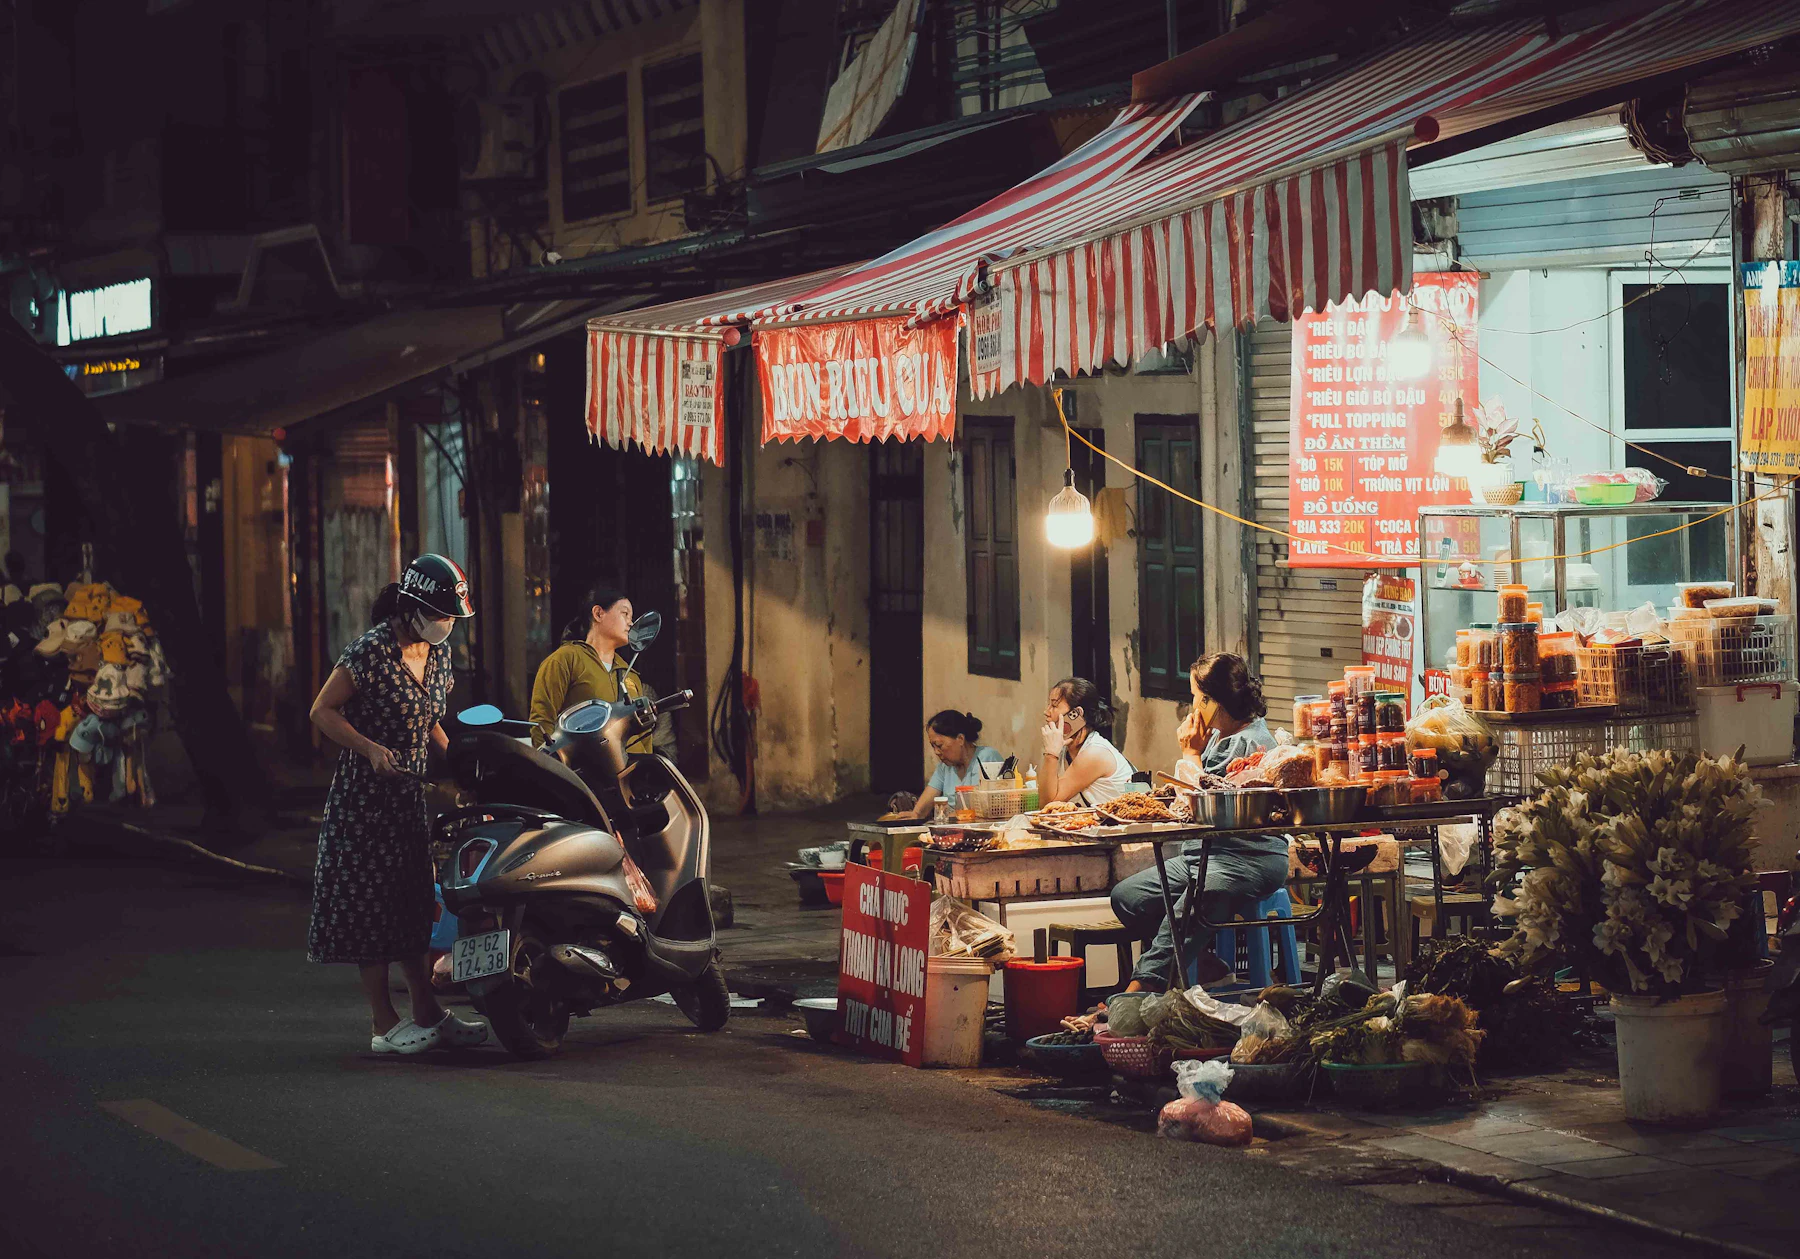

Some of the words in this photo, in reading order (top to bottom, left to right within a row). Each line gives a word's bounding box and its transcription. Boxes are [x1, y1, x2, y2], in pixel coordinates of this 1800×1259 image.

[1312, 318, 1342, 336] RIÊU
[1312, 342, 1342, 359] RIÊU
[1347, 338, 1364, 359] BÒ
[772, 346, 821, 421] BÚN
[826, 338, 891, 420] RIÊU
[896, 350, 951, 417] CUA
[1312, 365, 1342, 382] RIÊU
[1346, 366, 1371, 385] LỢN
[1312, 388, 1341, 406] RIÊU
[1346, 386, 1370, 405] GIÒ
[1373, 386, 1392, 405] BÒ
[1395, 387, 1426, 410] ĐẬU
[1312, 412, 1342, 429] FULL
[1345, 412, 1406, 428] TOPPING
[1438, 413, 1454, 428] 50
[1304, 432, 1327, 450] ĐỒ
[1331, 435, 1354, 450] ĂN
[1359, 434, 1406, 450] THÊM
[1301, 455, 1317, 472] BÒ
[1324, 458, 1343, 471] 15K
[1363, 455, 1385, 471] TÓP
[1388, 454, 1408, 471] MỠ
[1301, 475, 1320, 492] GIÒ
[1324, 478, 1343, 491] 10K
[1364, 474, 1402, 492] TRỨNG
[1405, 478, 1423, 494] VỊT
[1426, 477, 1450, 494] LỘN
[1455, 478, 1469, 491] 10
[1303, 496, 1327, 514] ĐỒ
[1331, 496, 1378, 514] UỐNG
[1297, 520, 1317, 534] BIA
[1320, 520, 1340, 534] 333
[1343, 520, 1365, 534] 20K
[1380, 520, 1412, 534] COCA
[1457, 519, 1478, 533] 15K
[1297, 541, 1328, 555] LAVIE
[1344, 541, 1365, 554] 10K
[1380, 538, 1401, 554] TRÀ
[1463, 540, 1478, 554] 5K
[1428, 672, 1446, 694] BÚN
[859, 876, 880, 919] CHẢ
[883, 889, 909, 931] MỰC
[461, 933, 500, 958] 29-G2
[458, 952, 504, 978] 124.38
[842, 928, 875, 983] THOAN
[876, 939, 891, 998] HẠ
[893, 944, 925, 998] LONG
[844, 999, 869, 1044] THỊT
[869, 1007, 892, 1047] CUA
